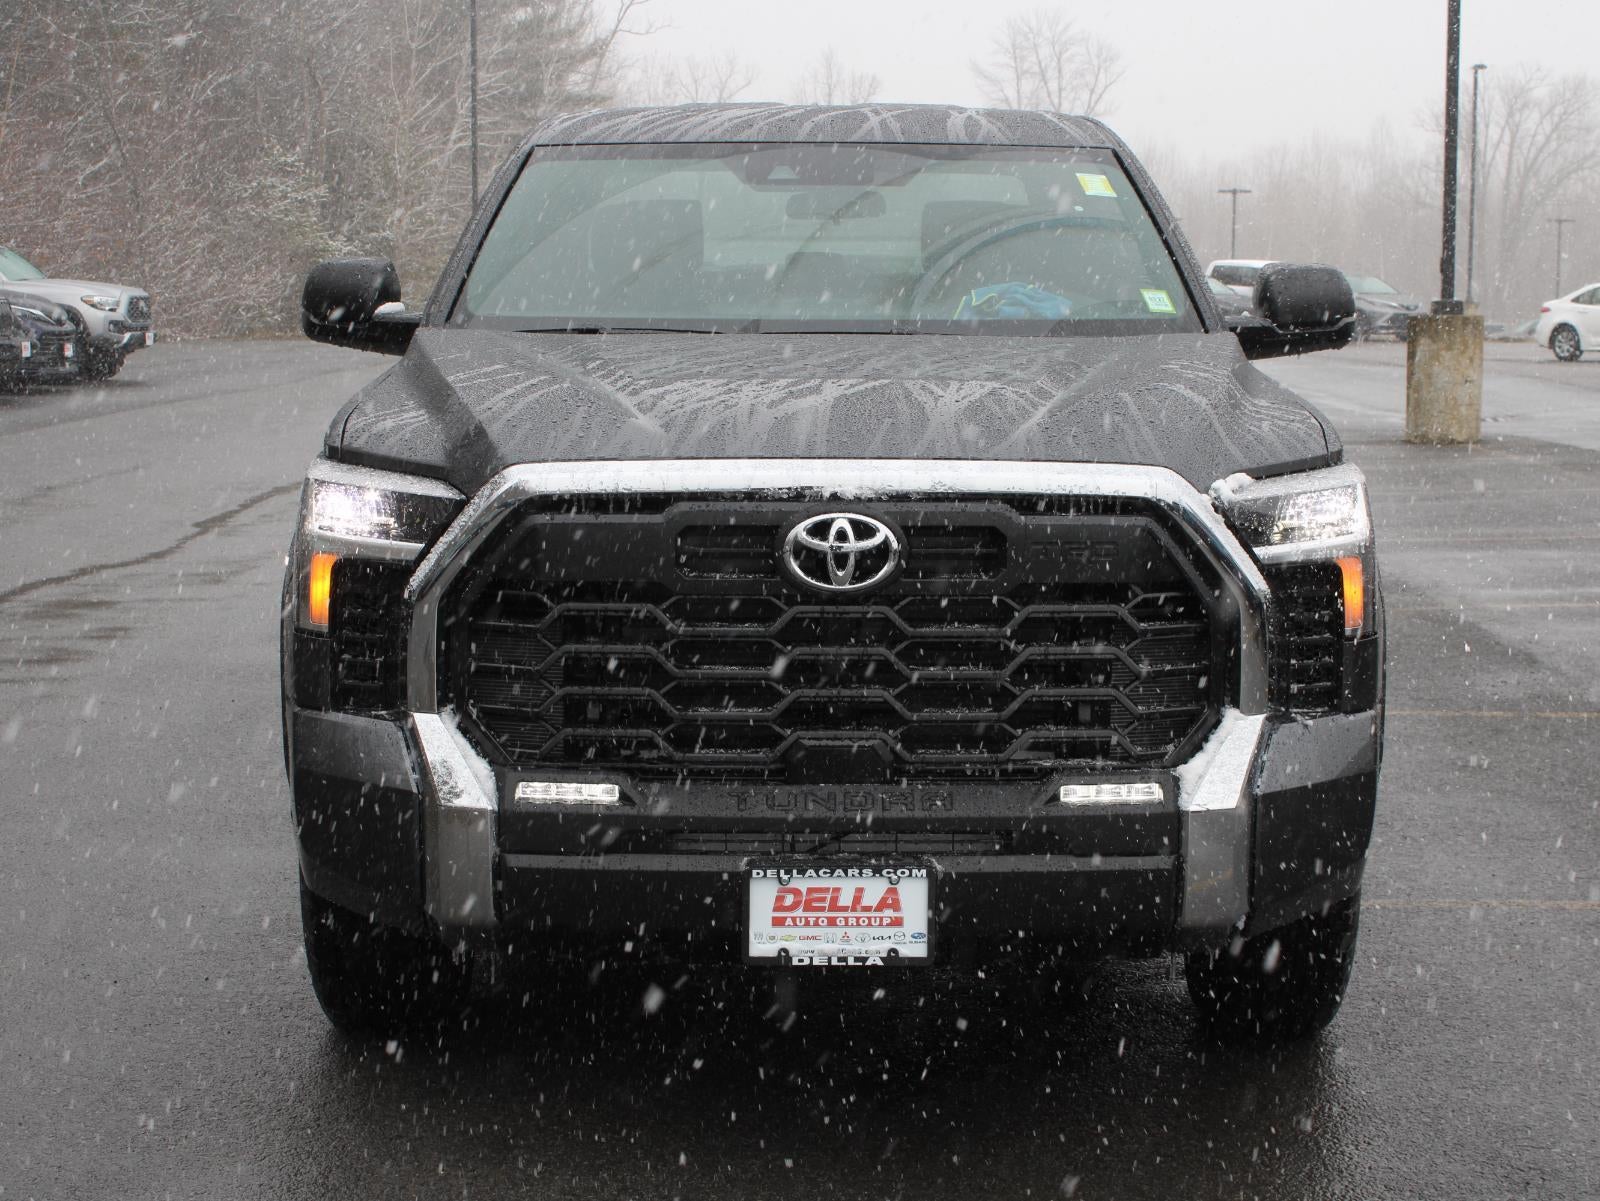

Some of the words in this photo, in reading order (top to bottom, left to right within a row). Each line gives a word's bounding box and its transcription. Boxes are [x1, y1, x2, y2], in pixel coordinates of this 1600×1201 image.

[726, 791, 954, 812] TUNDRA
[752, 868, 927, 878] DELLACARS.COM
[772, 886, 902, 913] DELLA
[785, 917, 828, 927] AUTO
[836, 917, 892, 927] GROUP
[791, 956, 885, 966] DELLA
